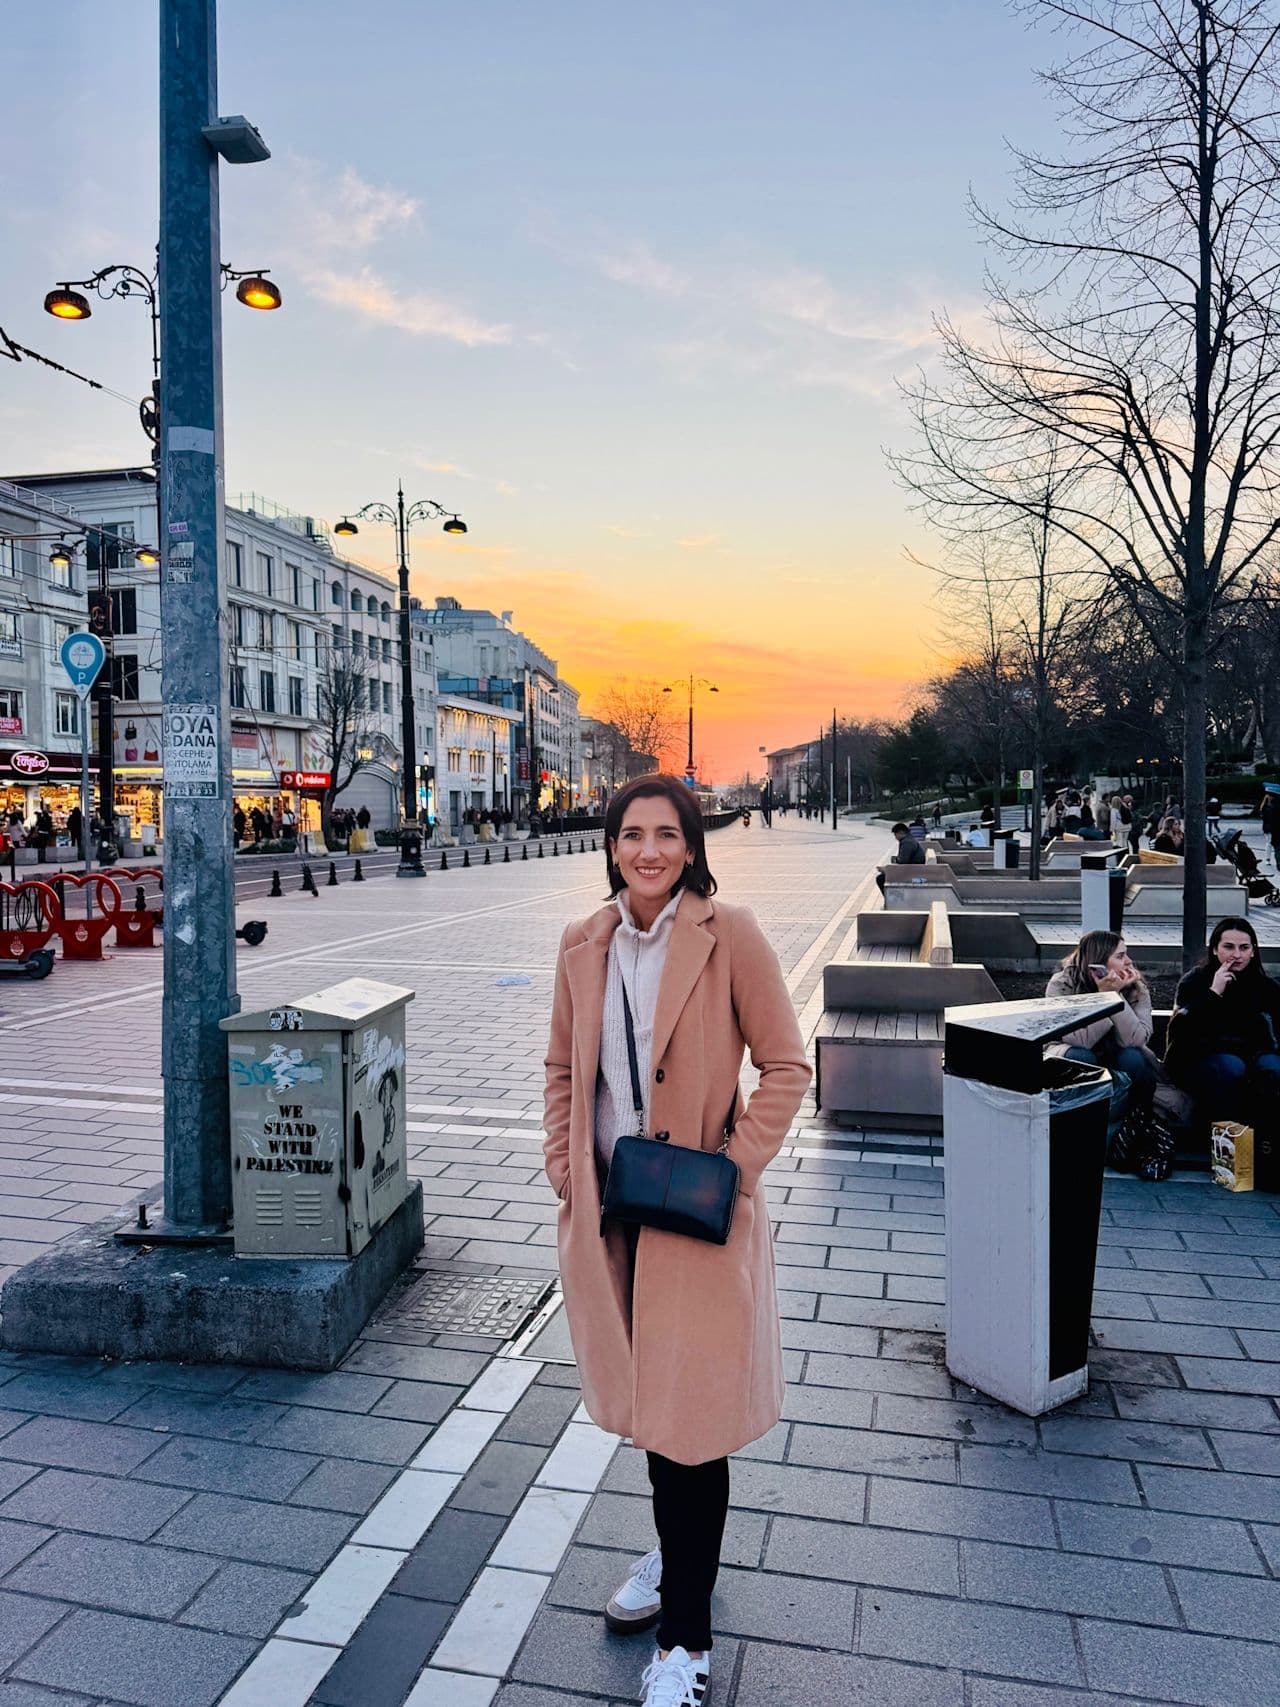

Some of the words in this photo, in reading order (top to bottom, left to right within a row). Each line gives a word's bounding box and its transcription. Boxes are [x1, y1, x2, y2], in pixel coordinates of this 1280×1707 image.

[279, 1104, 303, 1119] WE
[264, 1122, 317, 1137] STAND
[268, 1140, 312, 1155] WITH
[246, 1157, 334, 1174] PALESTINE
